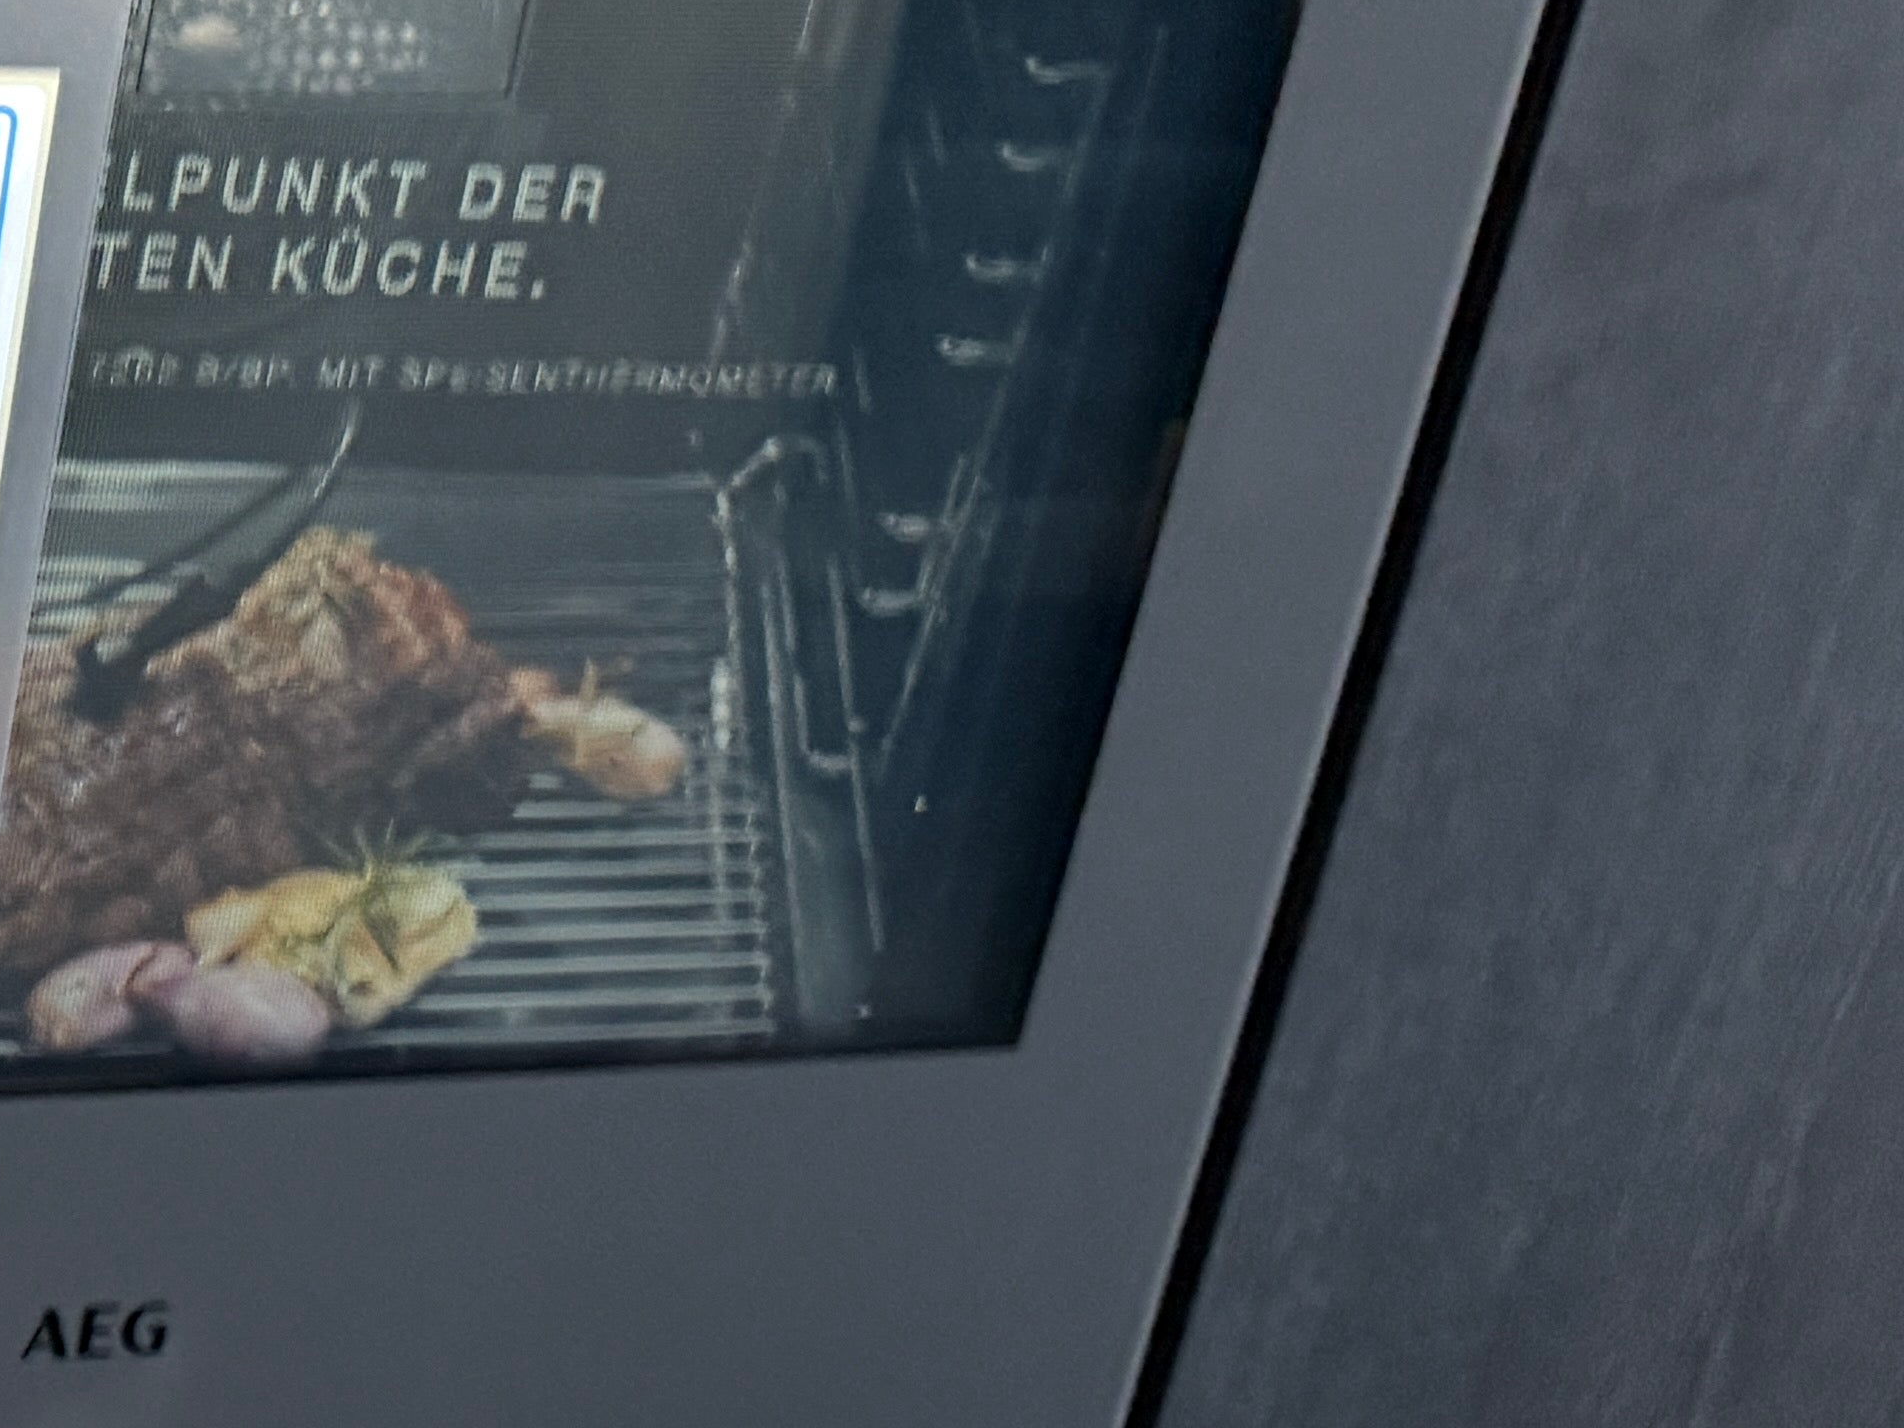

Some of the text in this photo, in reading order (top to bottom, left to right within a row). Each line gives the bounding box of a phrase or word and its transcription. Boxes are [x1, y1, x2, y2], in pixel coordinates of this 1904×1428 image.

[96, 148, 608, 225] LPUNKT DER
[270, 222, 548, 302] KÜCHE.
[20, 1299, 171, 1361] AEG
